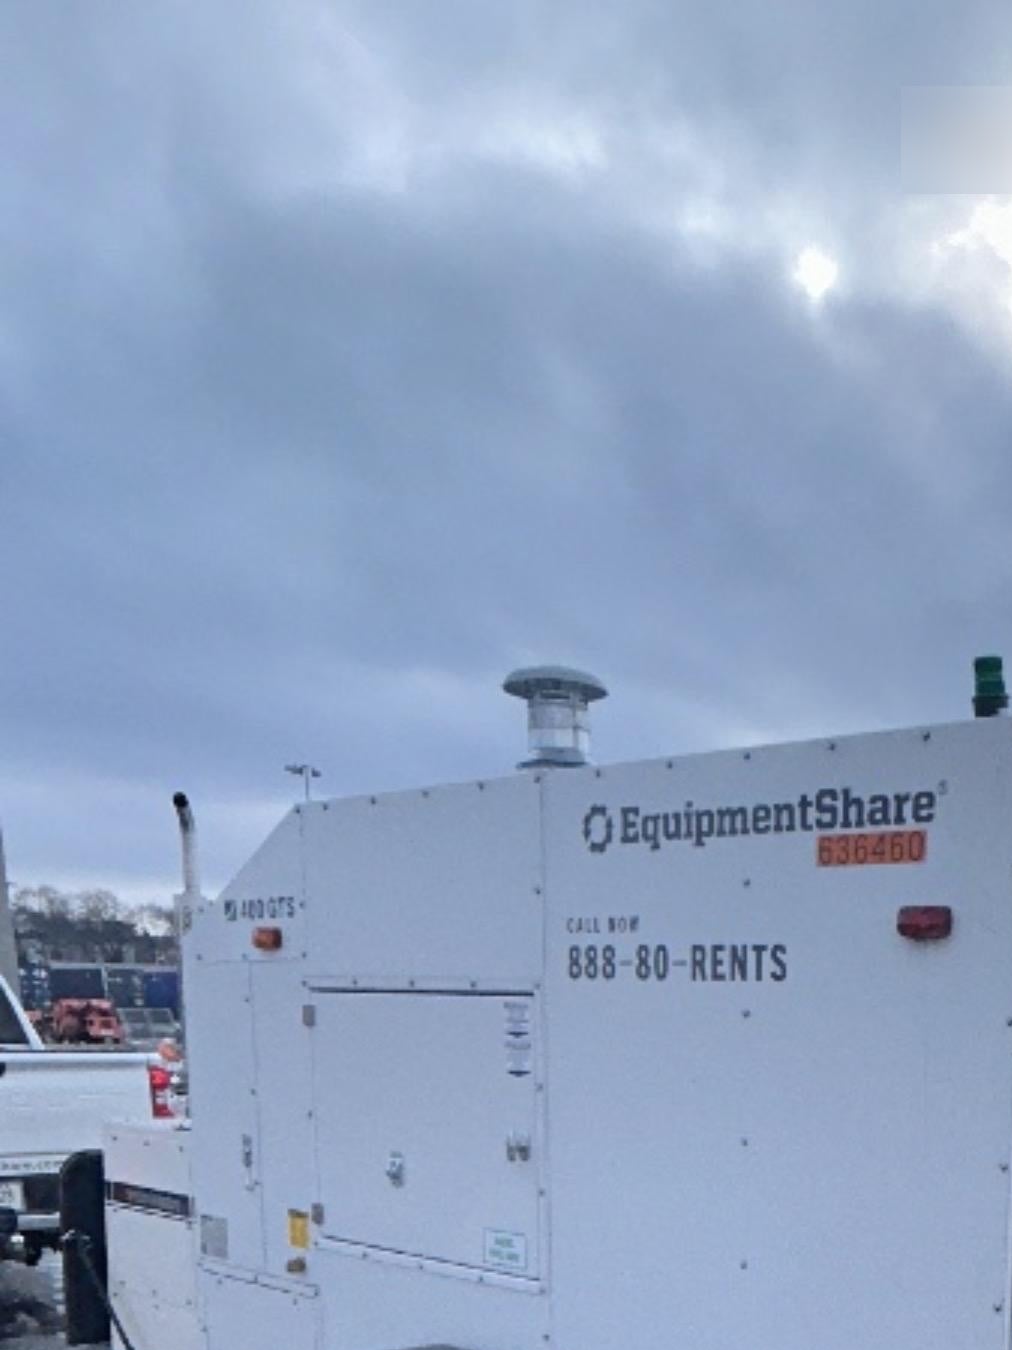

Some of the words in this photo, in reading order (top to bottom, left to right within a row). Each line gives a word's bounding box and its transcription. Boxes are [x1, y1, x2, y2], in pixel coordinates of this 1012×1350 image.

[619, 786, 938, 851] EquipmentShare
[817, 831, 926, 866] 636460
[566, 917, 601, 934] CALL
[607, 915, 640, 934] NOW
[568, 943, 788, 982] 888-80-RENTS
